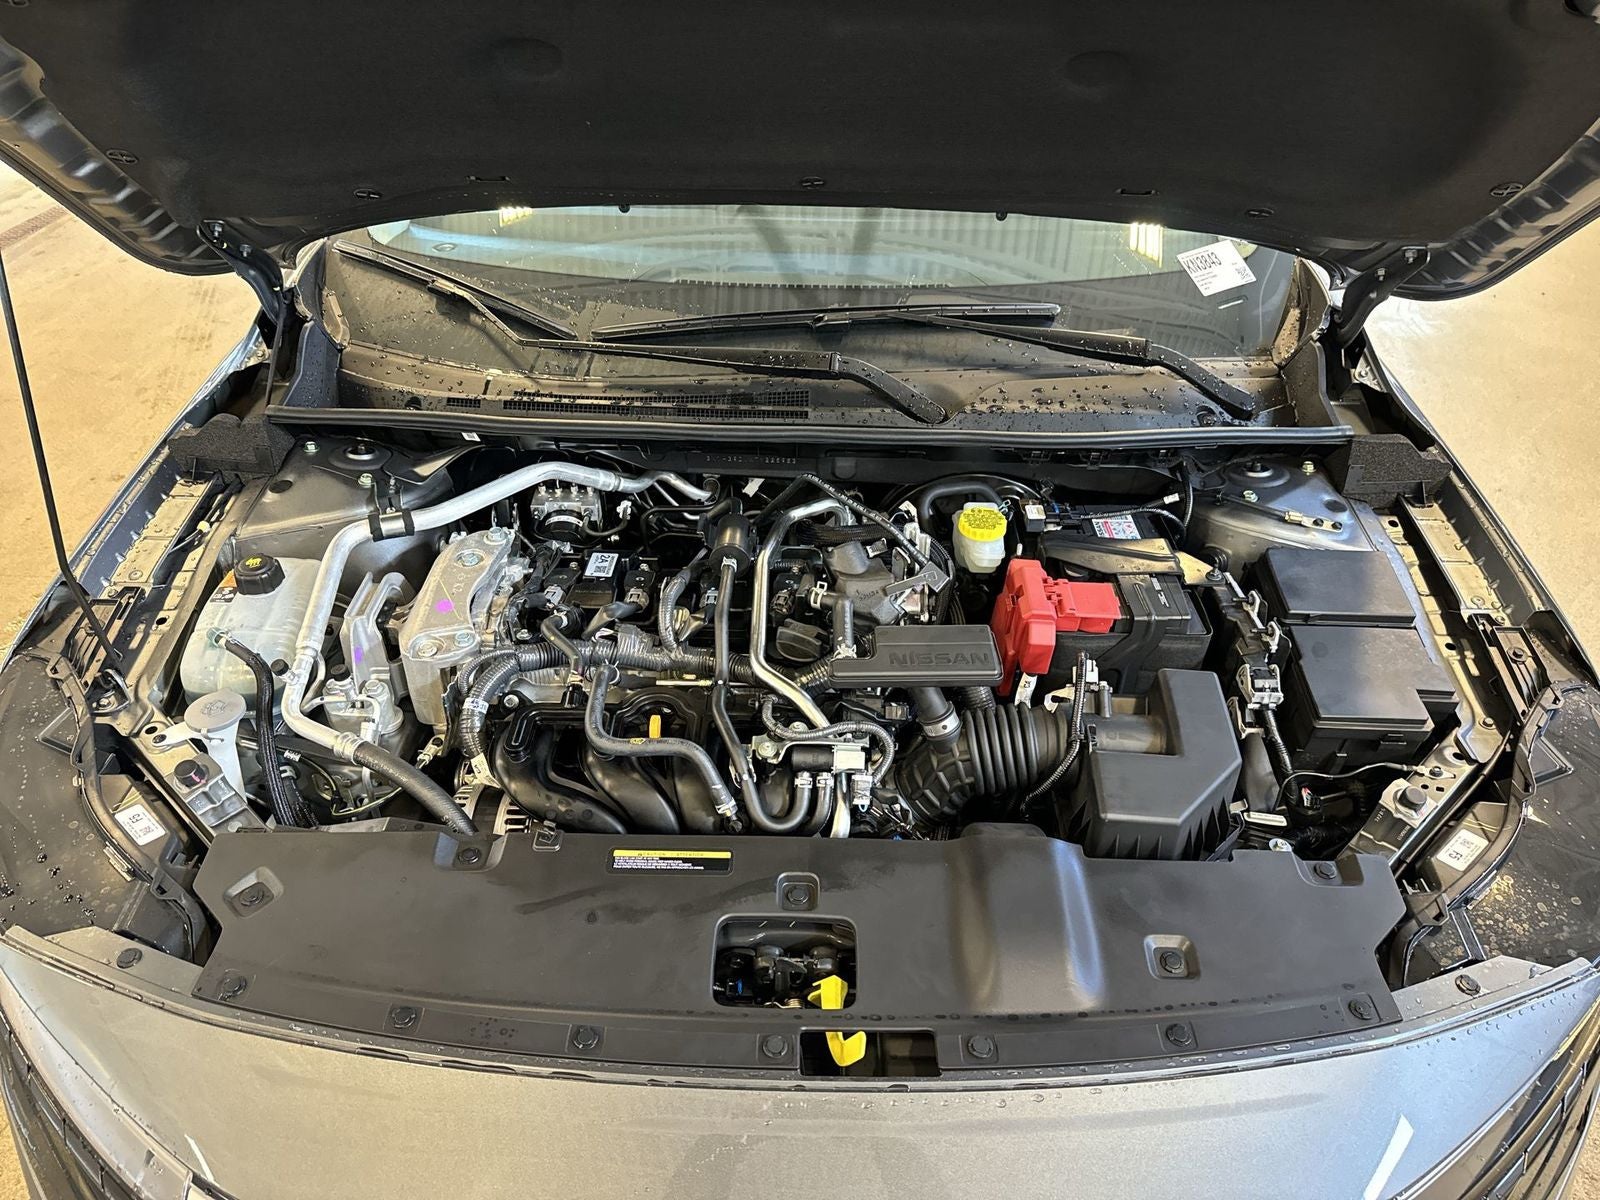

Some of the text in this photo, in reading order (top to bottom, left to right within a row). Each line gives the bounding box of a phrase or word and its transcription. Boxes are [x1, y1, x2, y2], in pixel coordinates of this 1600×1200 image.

[1183, 252, 1222, 274] KN3843
[597, 554, 610, 564] 2A
[888, 652, 990, 666] NISSAN
[1448, 850, 1463, 861] F5
